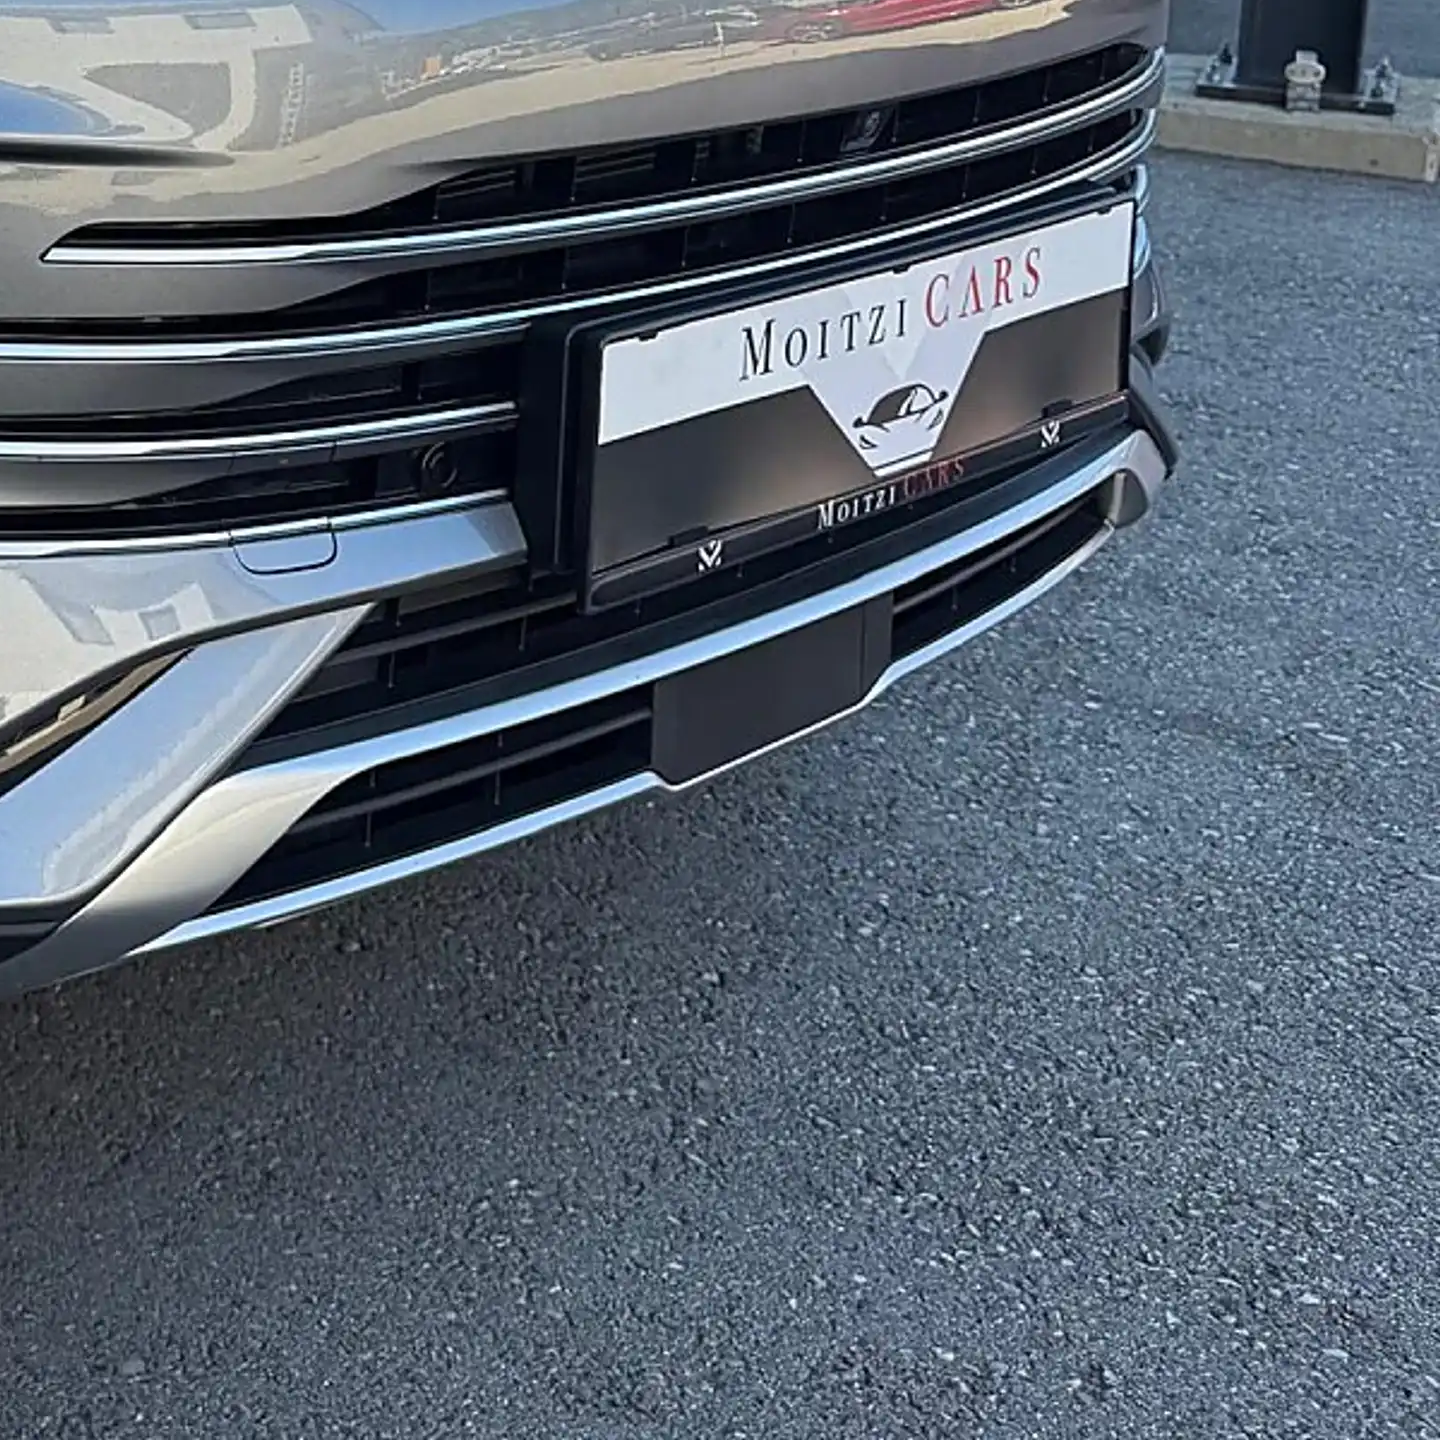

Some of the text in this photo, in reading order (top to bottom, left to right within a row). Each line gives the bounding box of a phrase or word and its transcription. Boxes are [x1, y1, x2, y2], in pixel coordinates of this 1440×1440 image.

[739, 246, 1042, 381] MOITZI CARS
[817, 484, 896, 531] MOITZI
